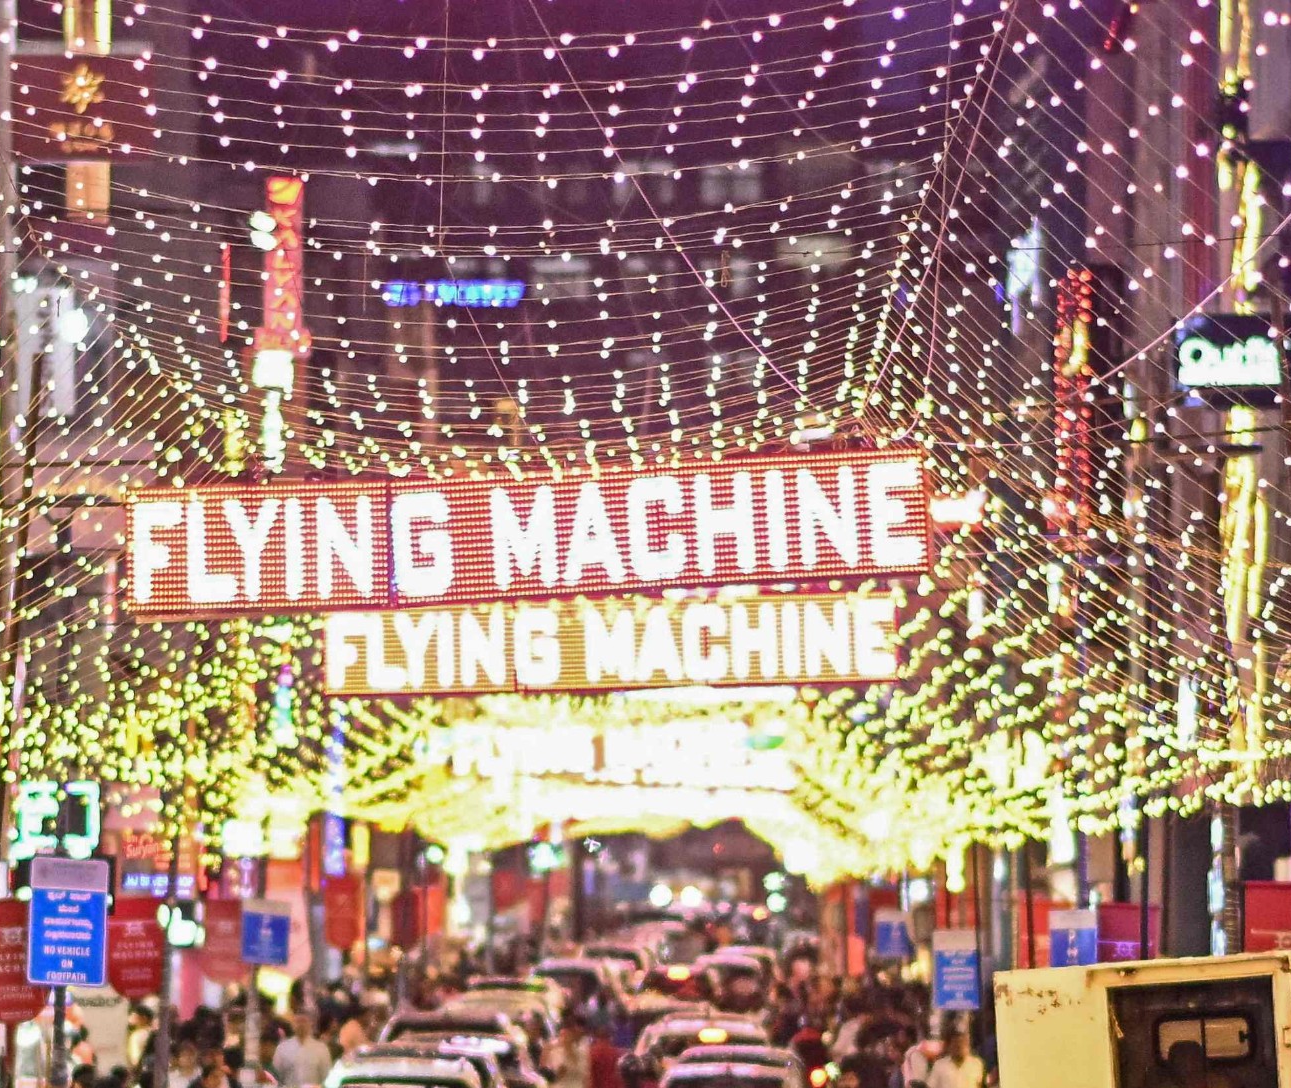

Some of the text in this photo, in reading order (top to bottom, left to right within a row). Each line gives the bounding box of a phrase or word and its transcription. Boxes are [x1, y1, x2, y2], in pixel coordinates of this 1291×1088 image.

[134, 462, 926, 602] FLYING MACHINE
[327, 598, 897, 690] FLYING MACHINE
[58, 946, 90, 957] VEHICLE
[61, 959, 73, 969] ON
[46, 971, 86, 982] FOOTPATH
